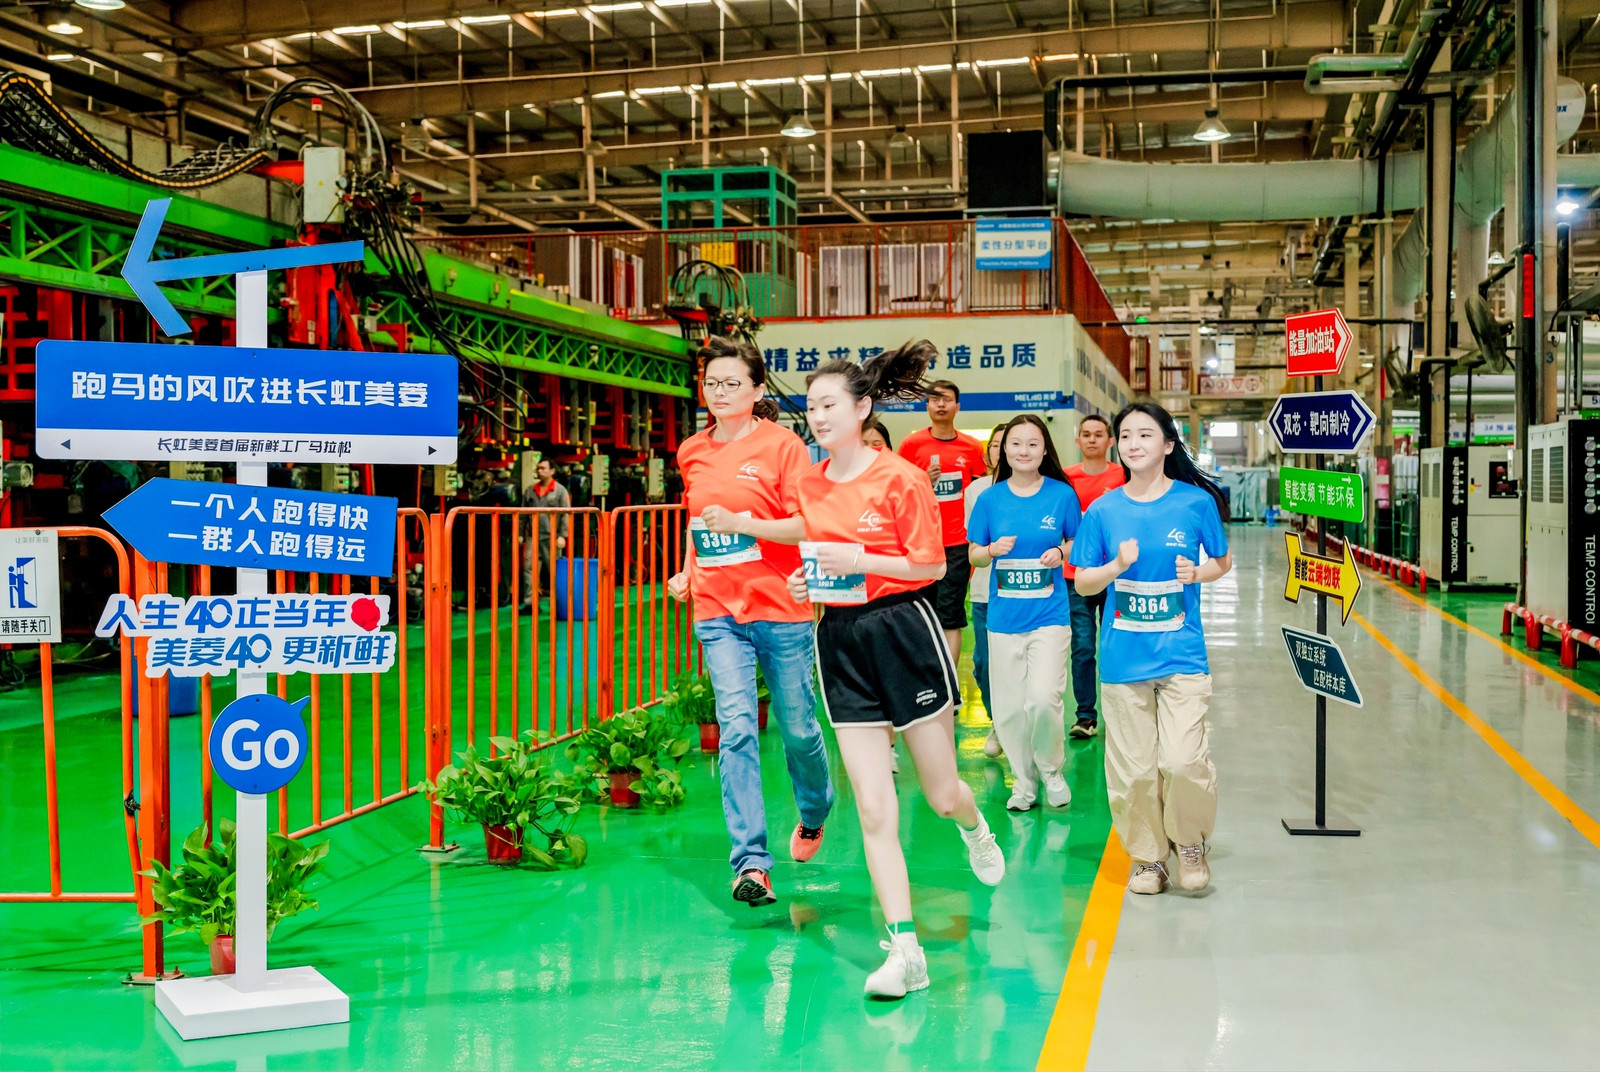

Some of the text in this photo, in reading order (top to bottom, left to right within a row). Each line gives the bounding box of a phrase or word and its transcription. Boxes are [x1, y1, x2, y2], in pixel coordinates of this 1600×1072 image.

[1289, 325, 1335, 357] 能量加油站
[72, 371, 429, 408] 跑马的风吹进长虹美菱
[157, 437, 351, 457] 长虹美菱首届新鲜工厂马拉松
[1285, 478, 1355, 509] 智能变频 节能环保
[171, 493, 369, 531] 一个人跑得快
[168, 525, 366, 563] 一群人跑得远
[1007, 571, 1041, 584] 3365
[1294, 556, 1340, 590] 智能云端物联
[102, 597, 348, 634] 人生40正当年
[1129, 595, 1169, 614] 3364
[1, 618, 47, 634] 请随手关门
[151, 633, 392, 669] 美菱40 更新鲜
[1295, 640, 1327, 667] 双独立系统
[1313, 668, 1347, 696] 匹配样本库
[221, 718, 300, 771] Go
